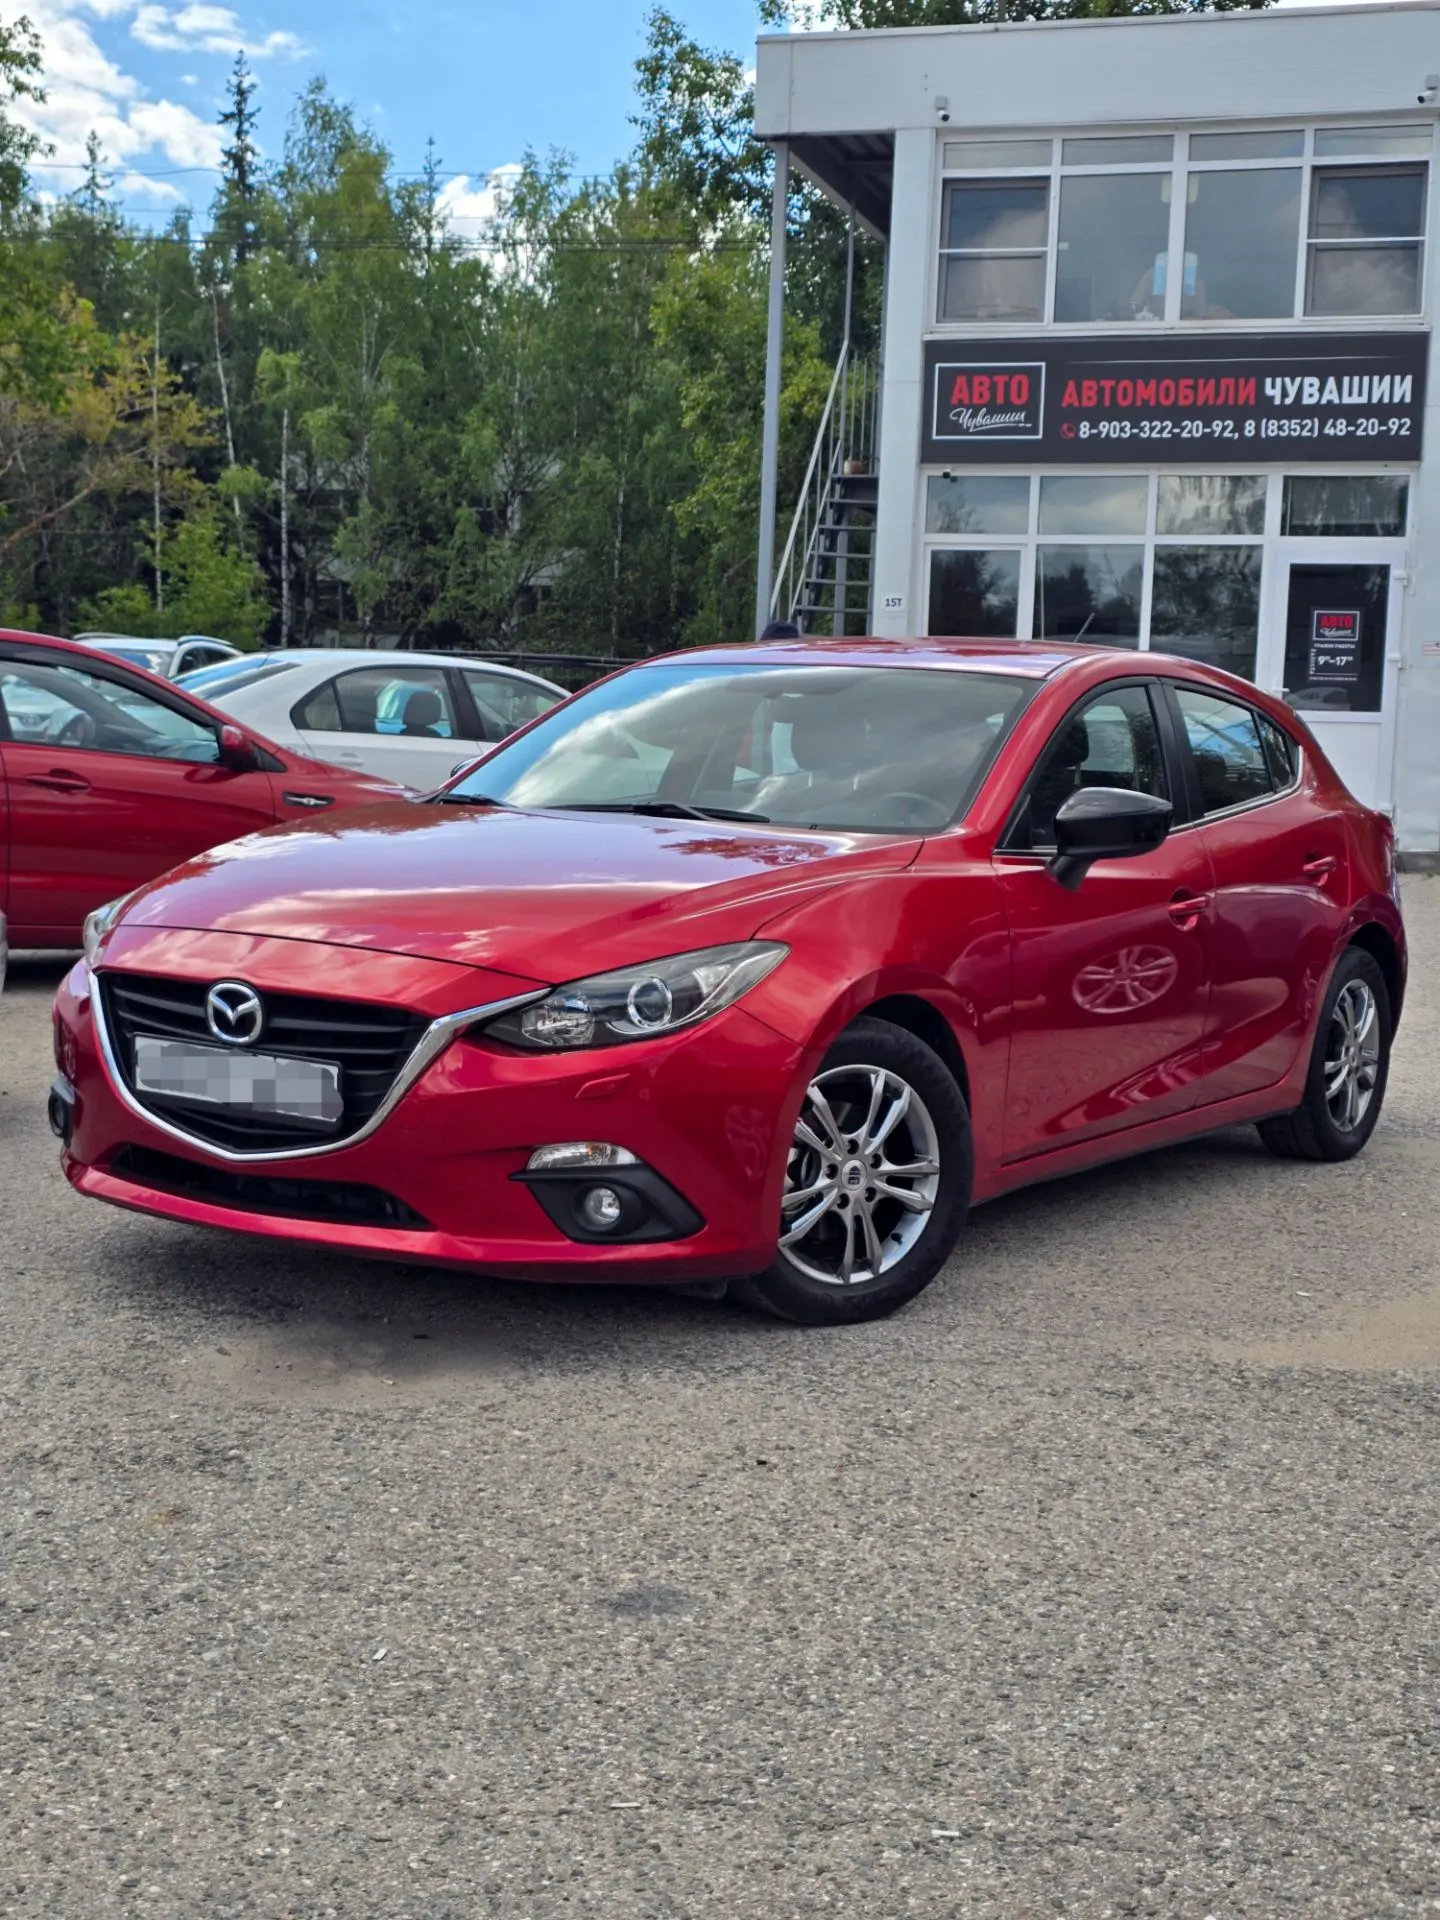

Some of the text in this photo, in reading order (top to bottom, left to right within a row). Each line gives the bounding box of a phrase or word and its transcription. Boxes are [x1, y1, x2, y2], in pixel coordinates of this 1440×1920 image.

[950, 373, 1030, 405] АВТО
[1061, 374, 1413, 408] АВТОМОБИЛИ ЧУВАШИИ
[949, 407, 1029, 431] Чувашии
[1079, 417, 1411, 440] 8-903-322-20-92, 8 (8352) 48-20-92
